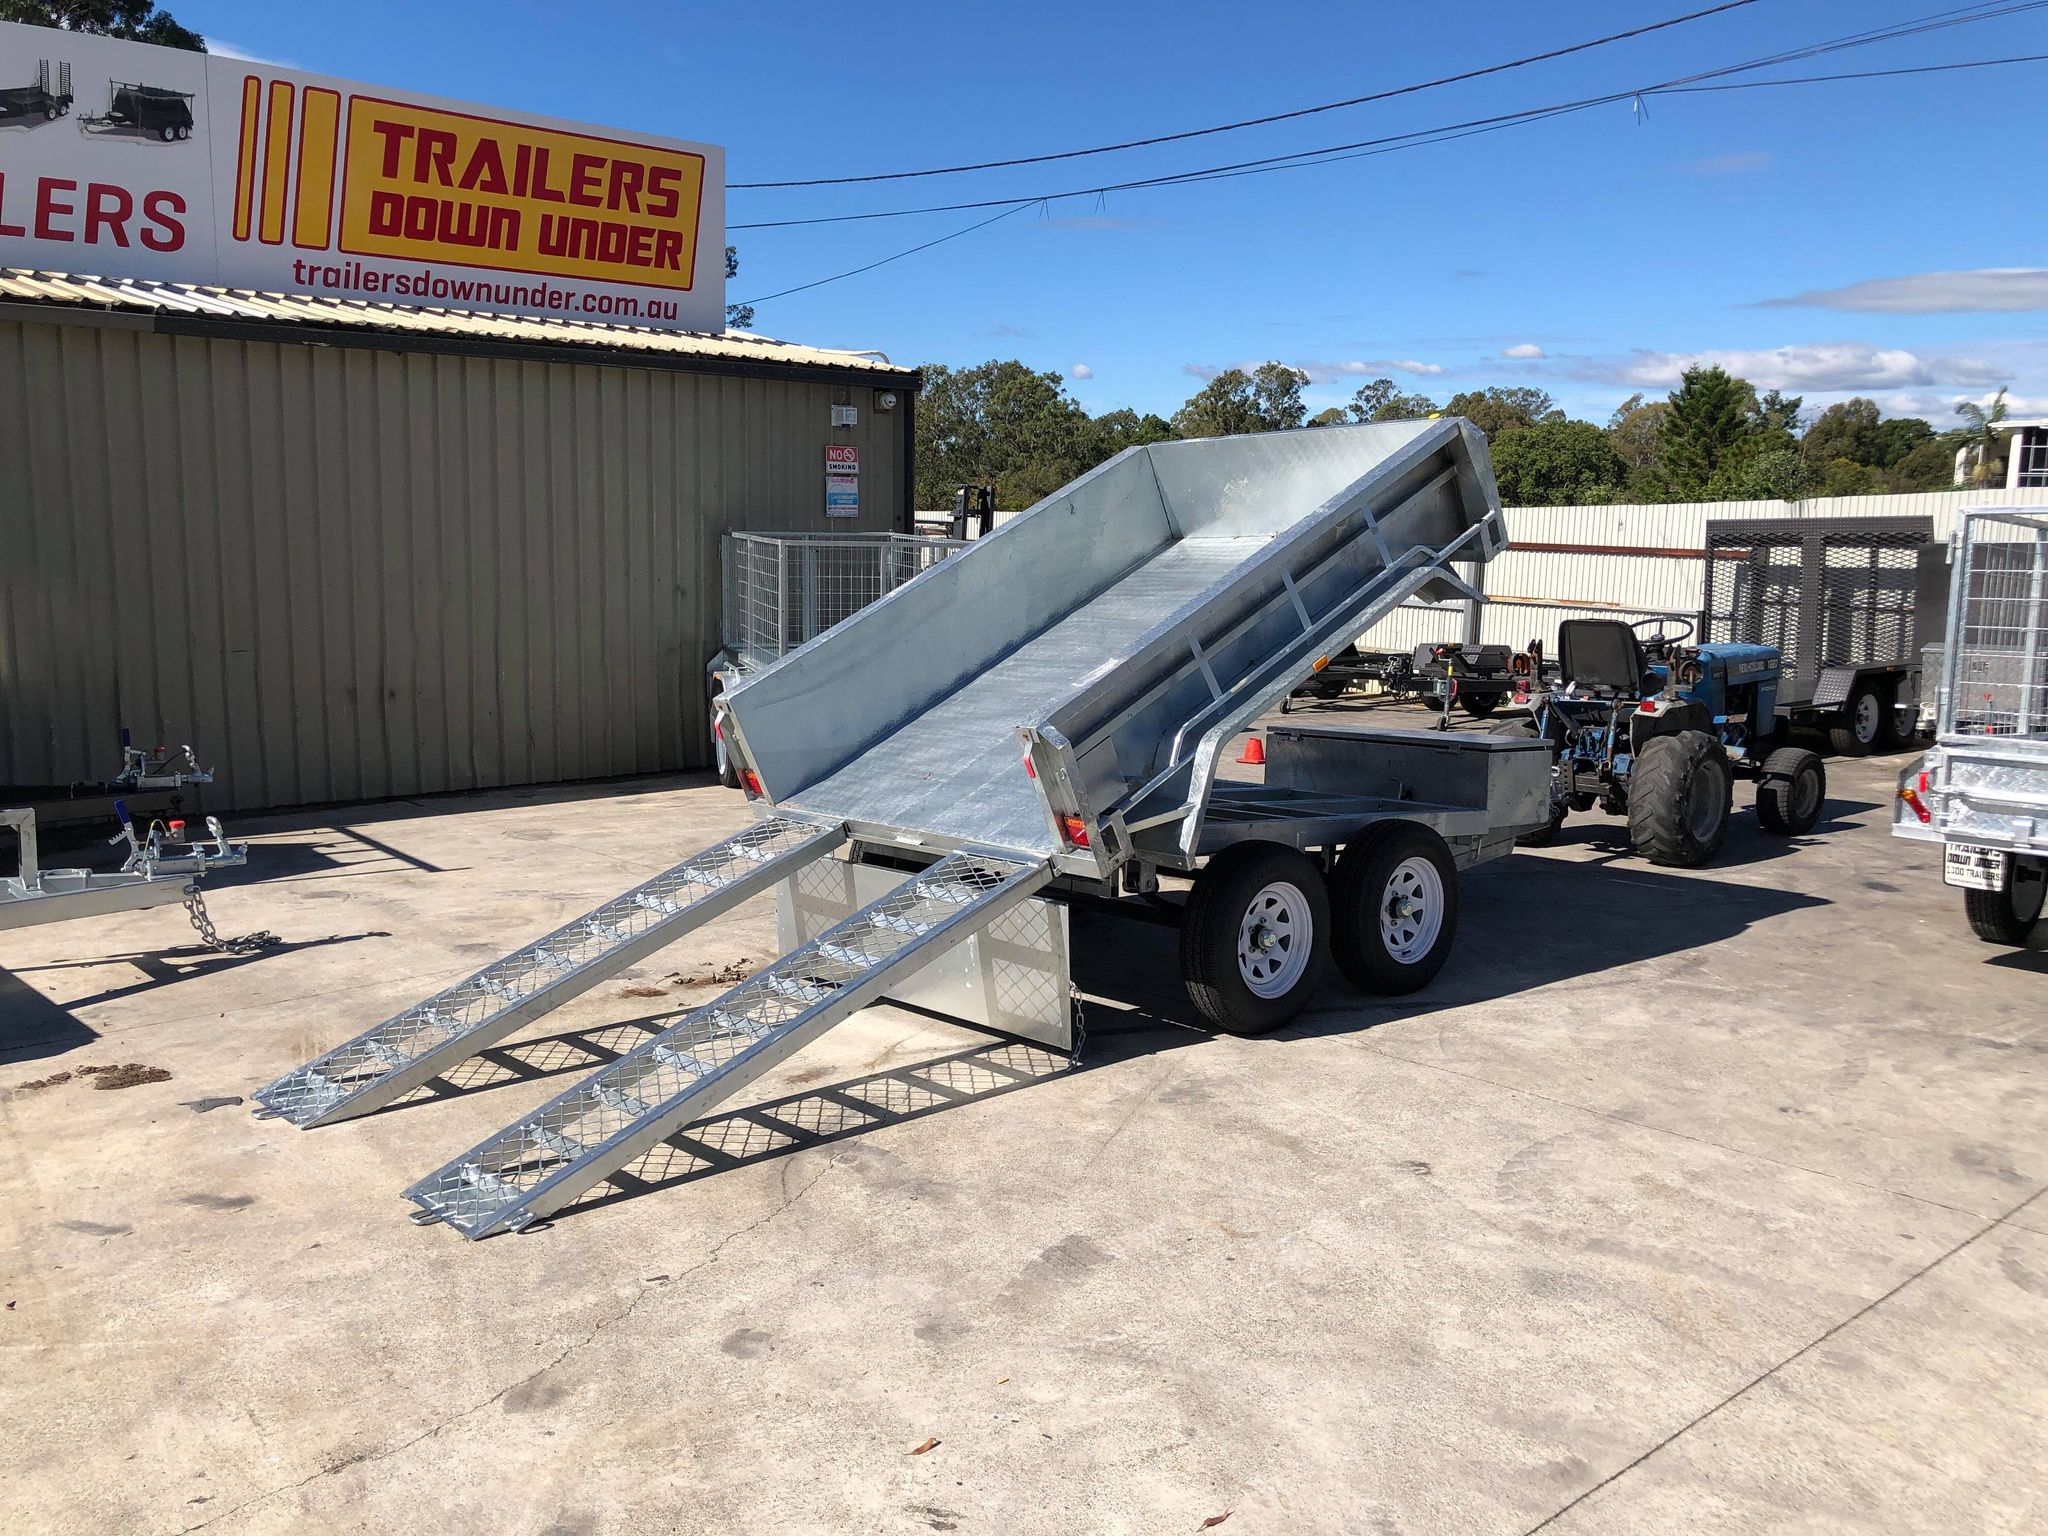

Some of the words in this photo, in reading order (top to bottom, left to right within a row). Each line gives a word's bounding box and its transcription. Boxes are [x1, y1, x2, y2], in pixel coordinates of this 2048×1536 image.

[373, 119, 683, 219] TRAILERS
[368, 190, 522, 252] DOWN
[537, 213, 684, 272] UNDER
[292, 259, 679, 321] trailersdownunder.com.au
[828, 463, 857, 471] SMOKING
[829, 449, 843, 460] NO
[1966, 868, 2001, 881] TRAILERS
